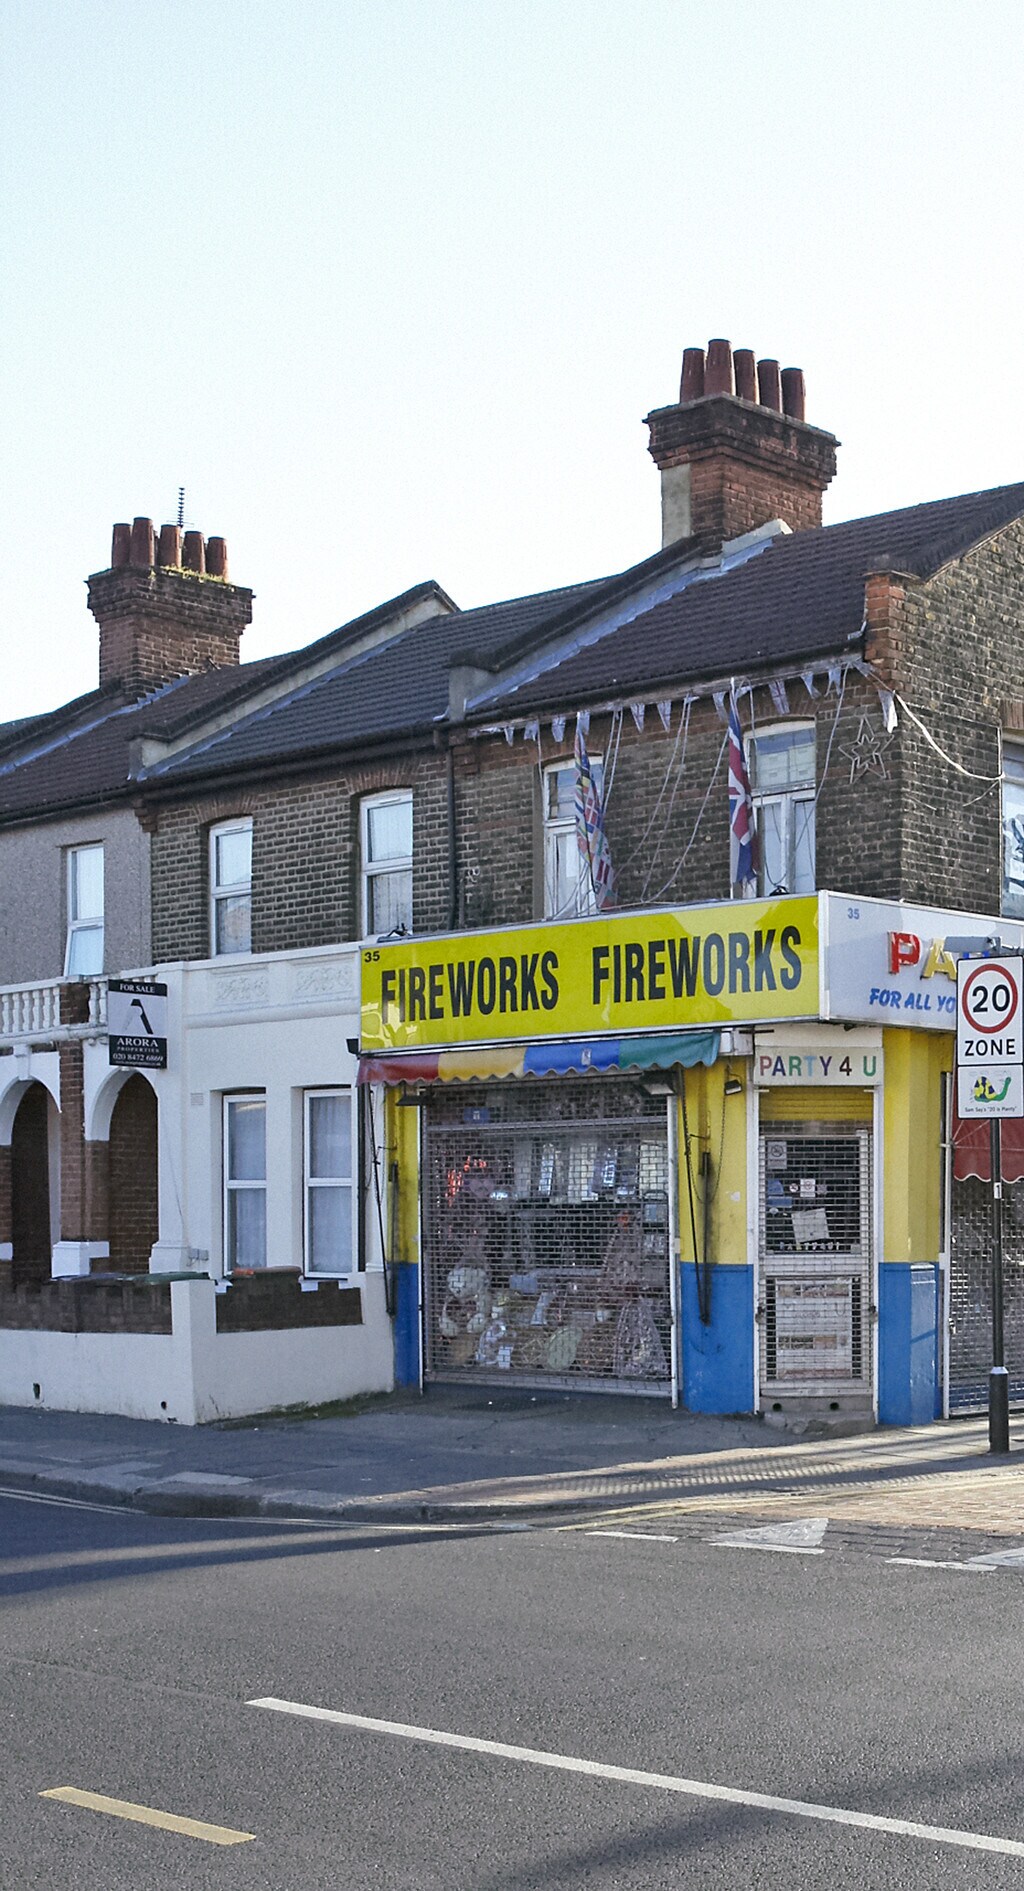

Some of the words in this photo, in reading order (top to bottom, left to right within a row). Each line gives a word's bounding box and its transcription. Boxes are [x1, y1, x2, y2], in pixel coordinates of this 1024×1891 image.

[847, 908, 860, 920] 35
[364, 951, 381, 963] 35
[381, 950, 560, 1025] FIREWORKS
[592, 925, 802, 1005] FIREWORKS
[120, 983, 134, 992] FOR
[136, 985, 155, 993] SALE
[869, 988, 901, 1009] FOR
[904, 993, 931, 1011] ALL
[972, 984, 1010, 1013] 20
[117, 1038, 158, 1047] ARORA
[964, 1039, 1016, 1057] ZONE
[759, 1055, 833, 1077] PARTY
[839, 1055, 852, 1077] 4
[863, 1055, 877, 1077] U
